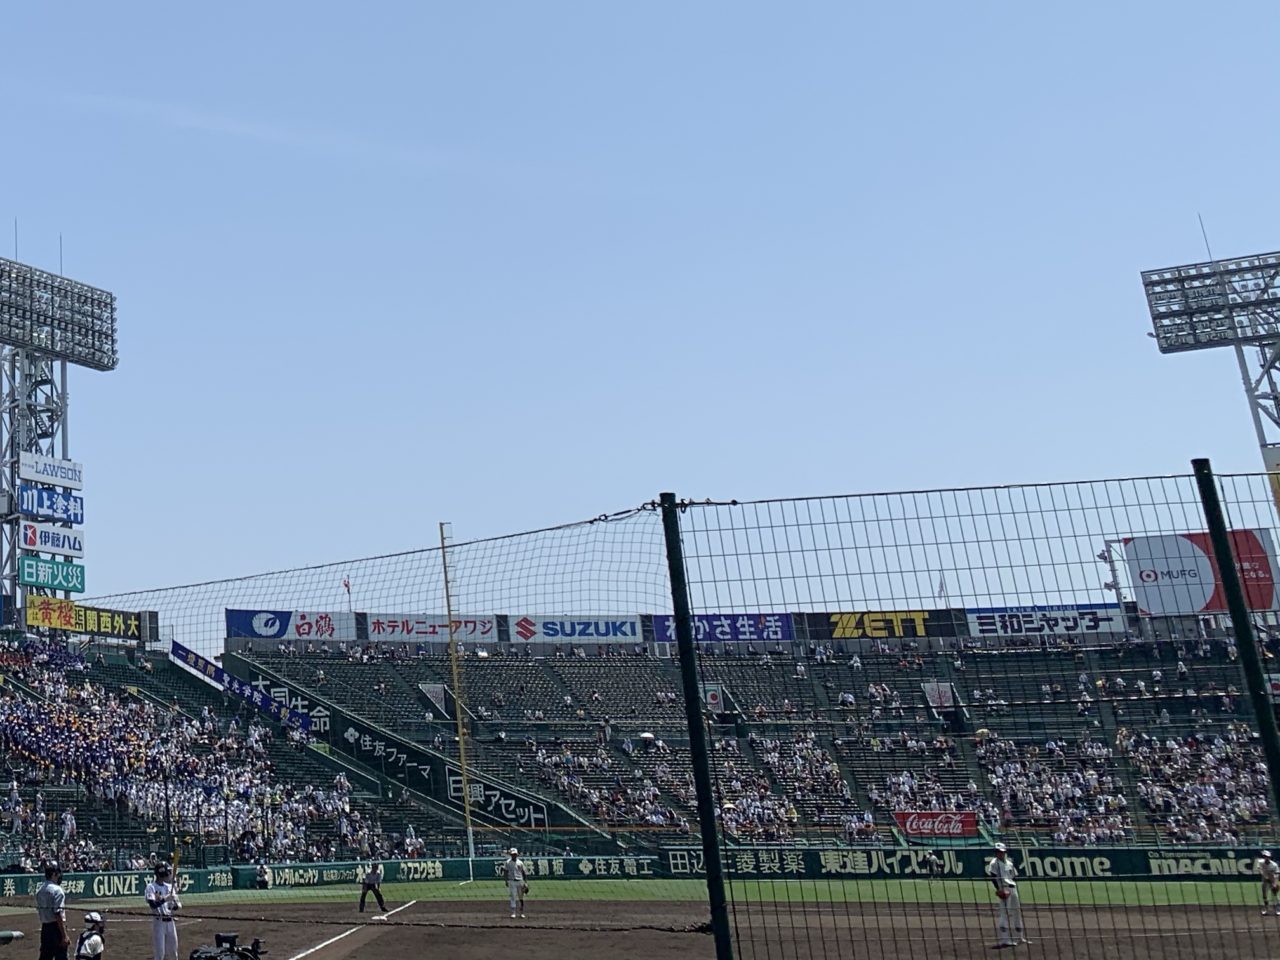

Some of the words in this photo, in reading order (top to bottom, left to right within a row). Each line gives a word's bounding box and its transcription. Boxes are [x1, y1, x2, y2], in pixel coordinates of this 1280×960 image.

[35, 461, 81, 482] LAWSON
[23, 490, 82, 522] 川上塗料
[39, 529, 82, 552] 伊藤ハム
[24, 562, 82, 589] 日新火災
[1161, 569, 1198, 580] MUFG
[371, 618, 493, 636] ホテルニューアワジ
[542, 620, 637, 638] SUZUKI
[830, 612, 929, 638] ZETT
[976, 610, 1114, 634] 三和シャッター
[360, 734, 431, 779] 住友ファーマ
[449, 776, 545, 828] 日興アセット
[595, 859, 653, 875] 住友電工
[819, 851, 963, 874] 東進ハイスル
[1020, 849, 1112, 876] home
[93, 875, 139, 897] GUNZE
